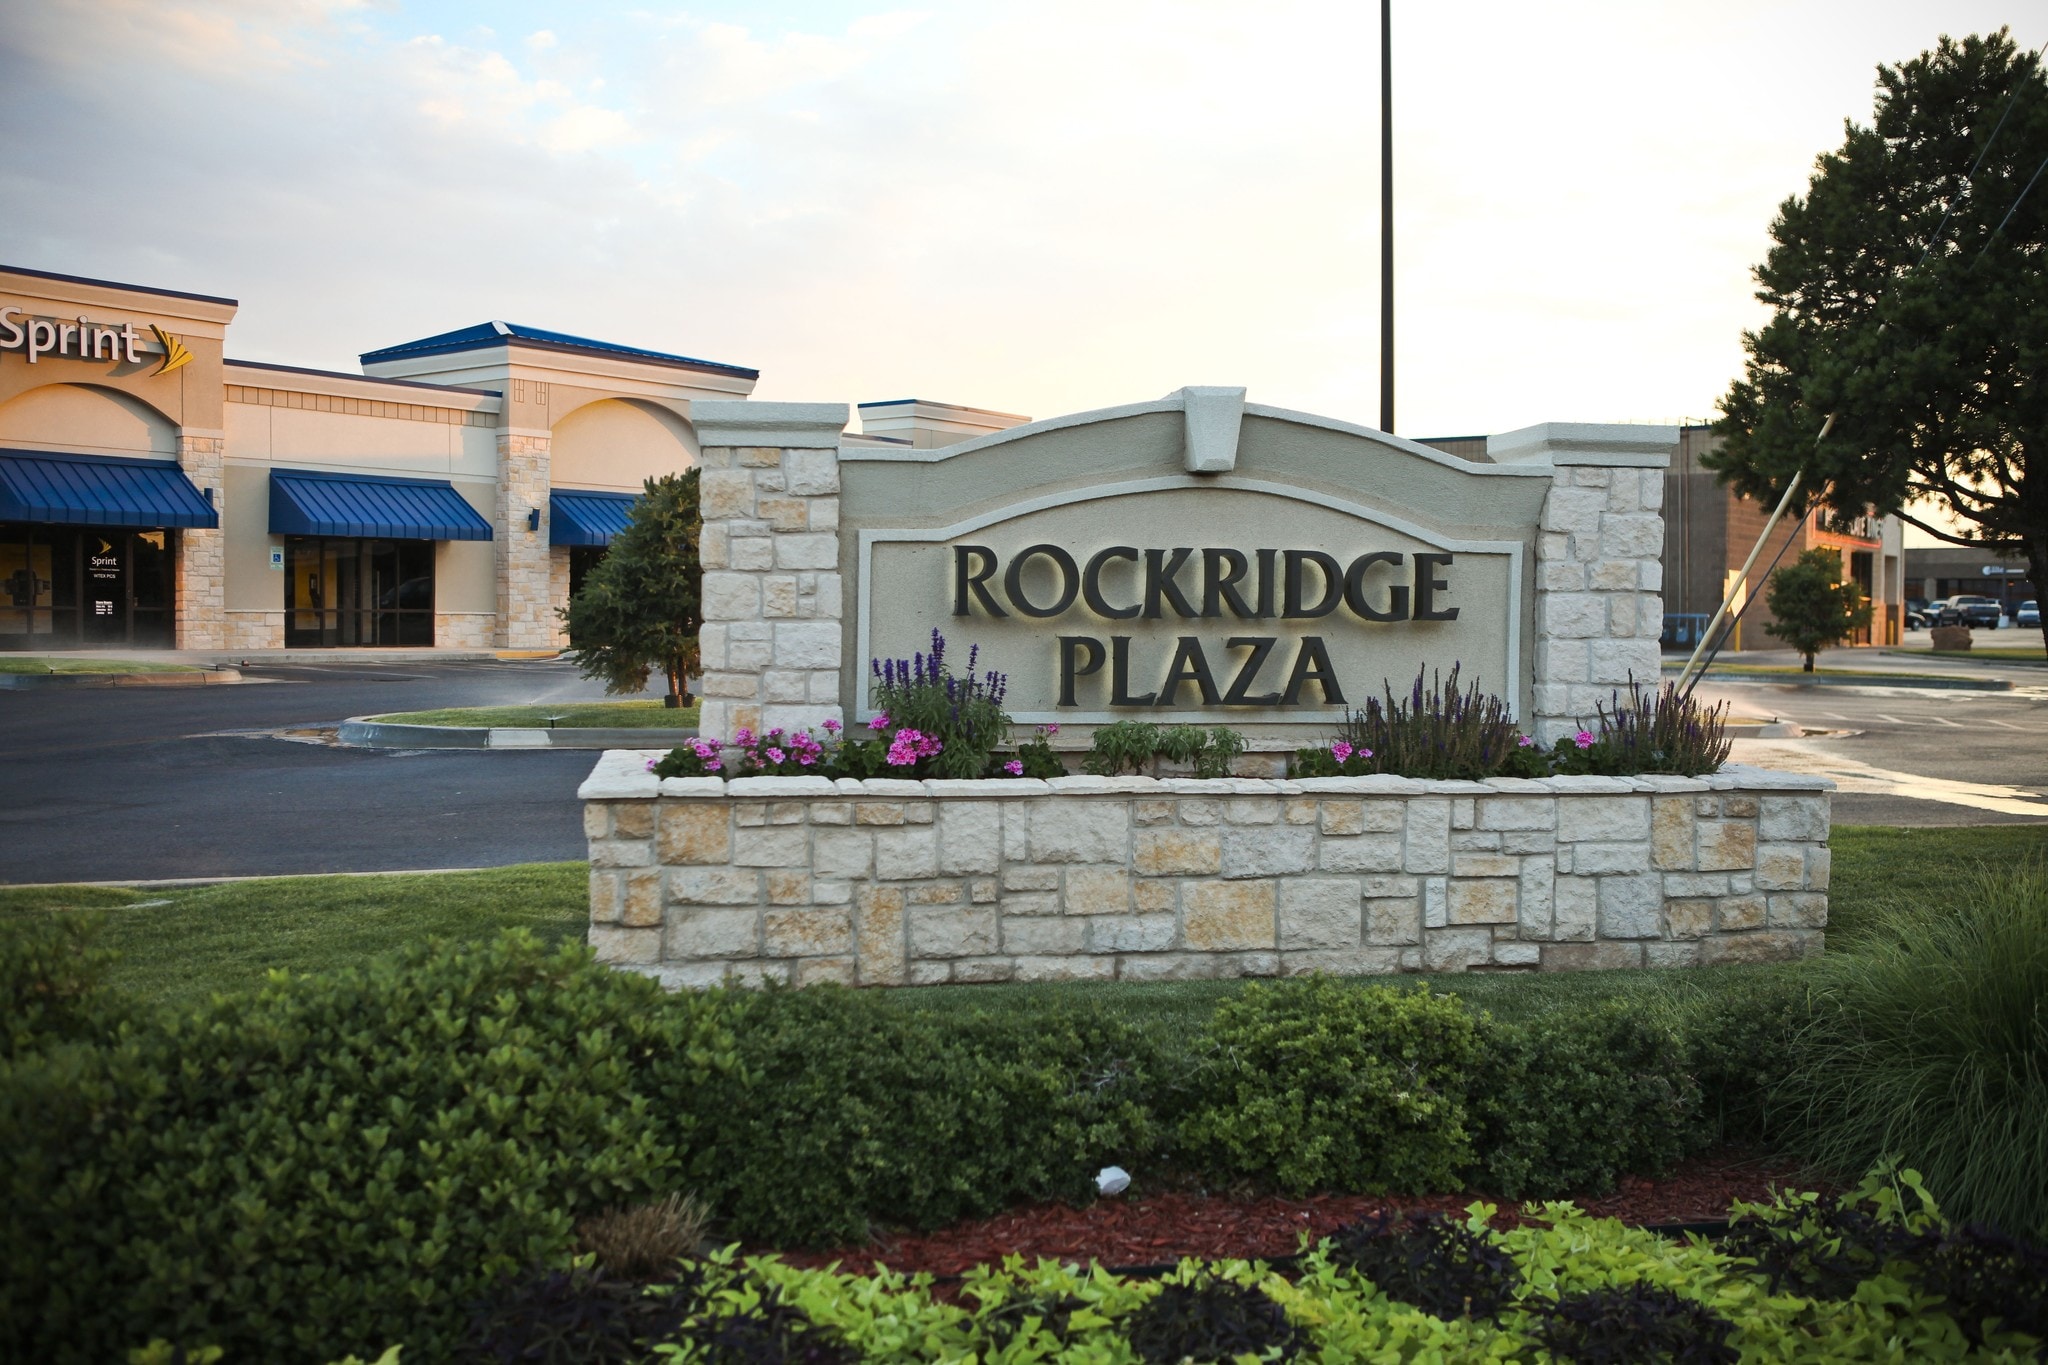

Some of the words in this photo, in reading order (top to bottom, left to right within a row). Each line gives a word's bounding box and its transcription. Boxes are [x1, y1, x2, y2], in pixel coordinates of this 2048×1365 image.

[0, 306, 141, 364] Sprint
[91, 556, 117, 567] Sprint
[952, 543, 1460, 623] ROCKRIDGE
[1056, 636, 1349, 707] PLAZA
